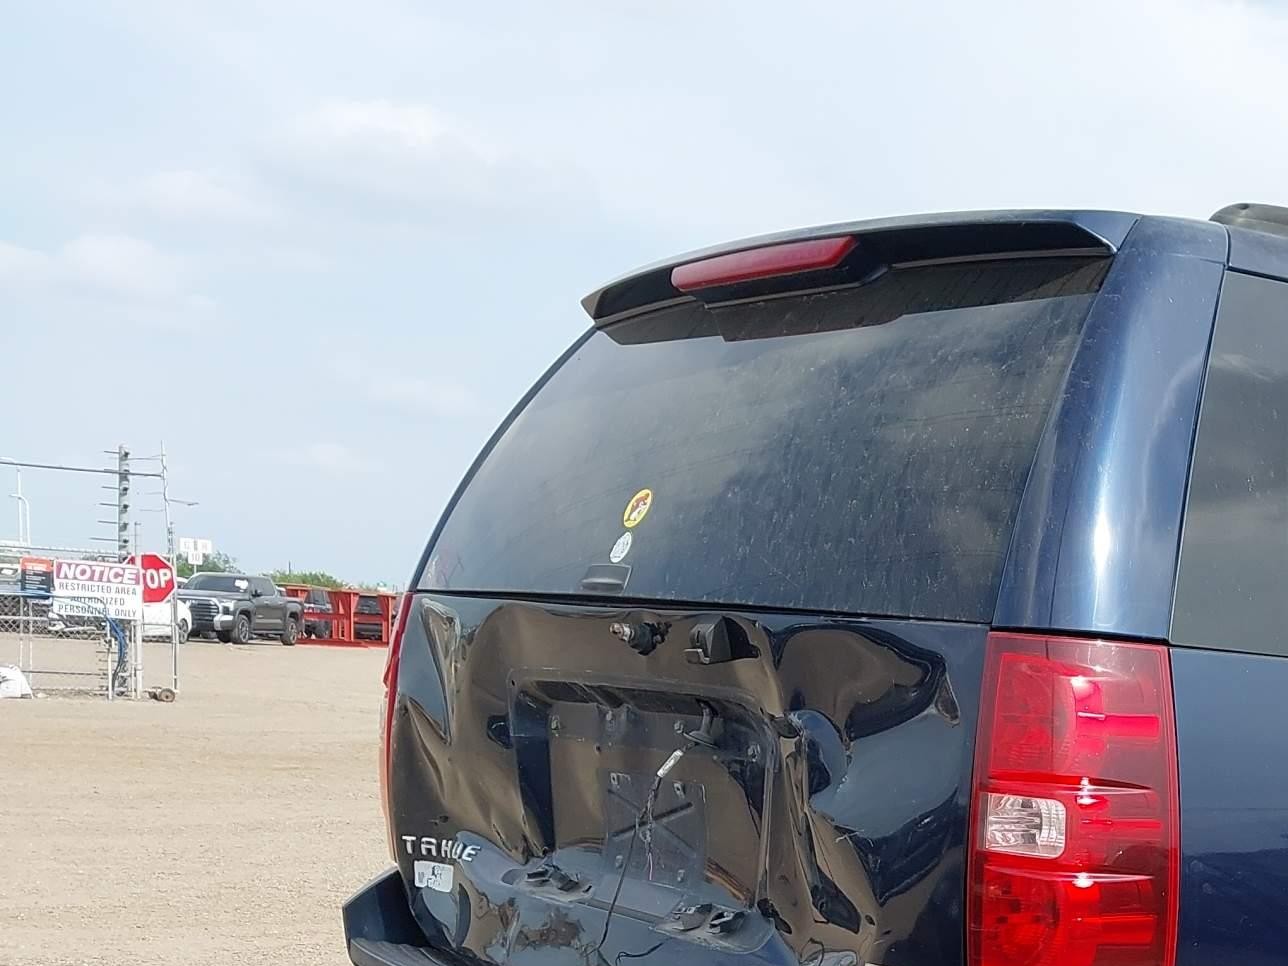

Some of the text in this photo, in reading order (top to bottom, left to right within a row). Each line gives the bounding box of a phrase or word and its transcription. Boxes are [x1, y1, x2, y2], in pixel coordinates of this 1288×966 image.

[59, 563, 138, 585] NOTICE
[142, 568, 172, 590] OP
[58, 581, 137, 596] RESTRICTED AREA
[58, 604, 137, 617] PERSONNEL ONLY
[401, 834, 482, 862] TAHOE
